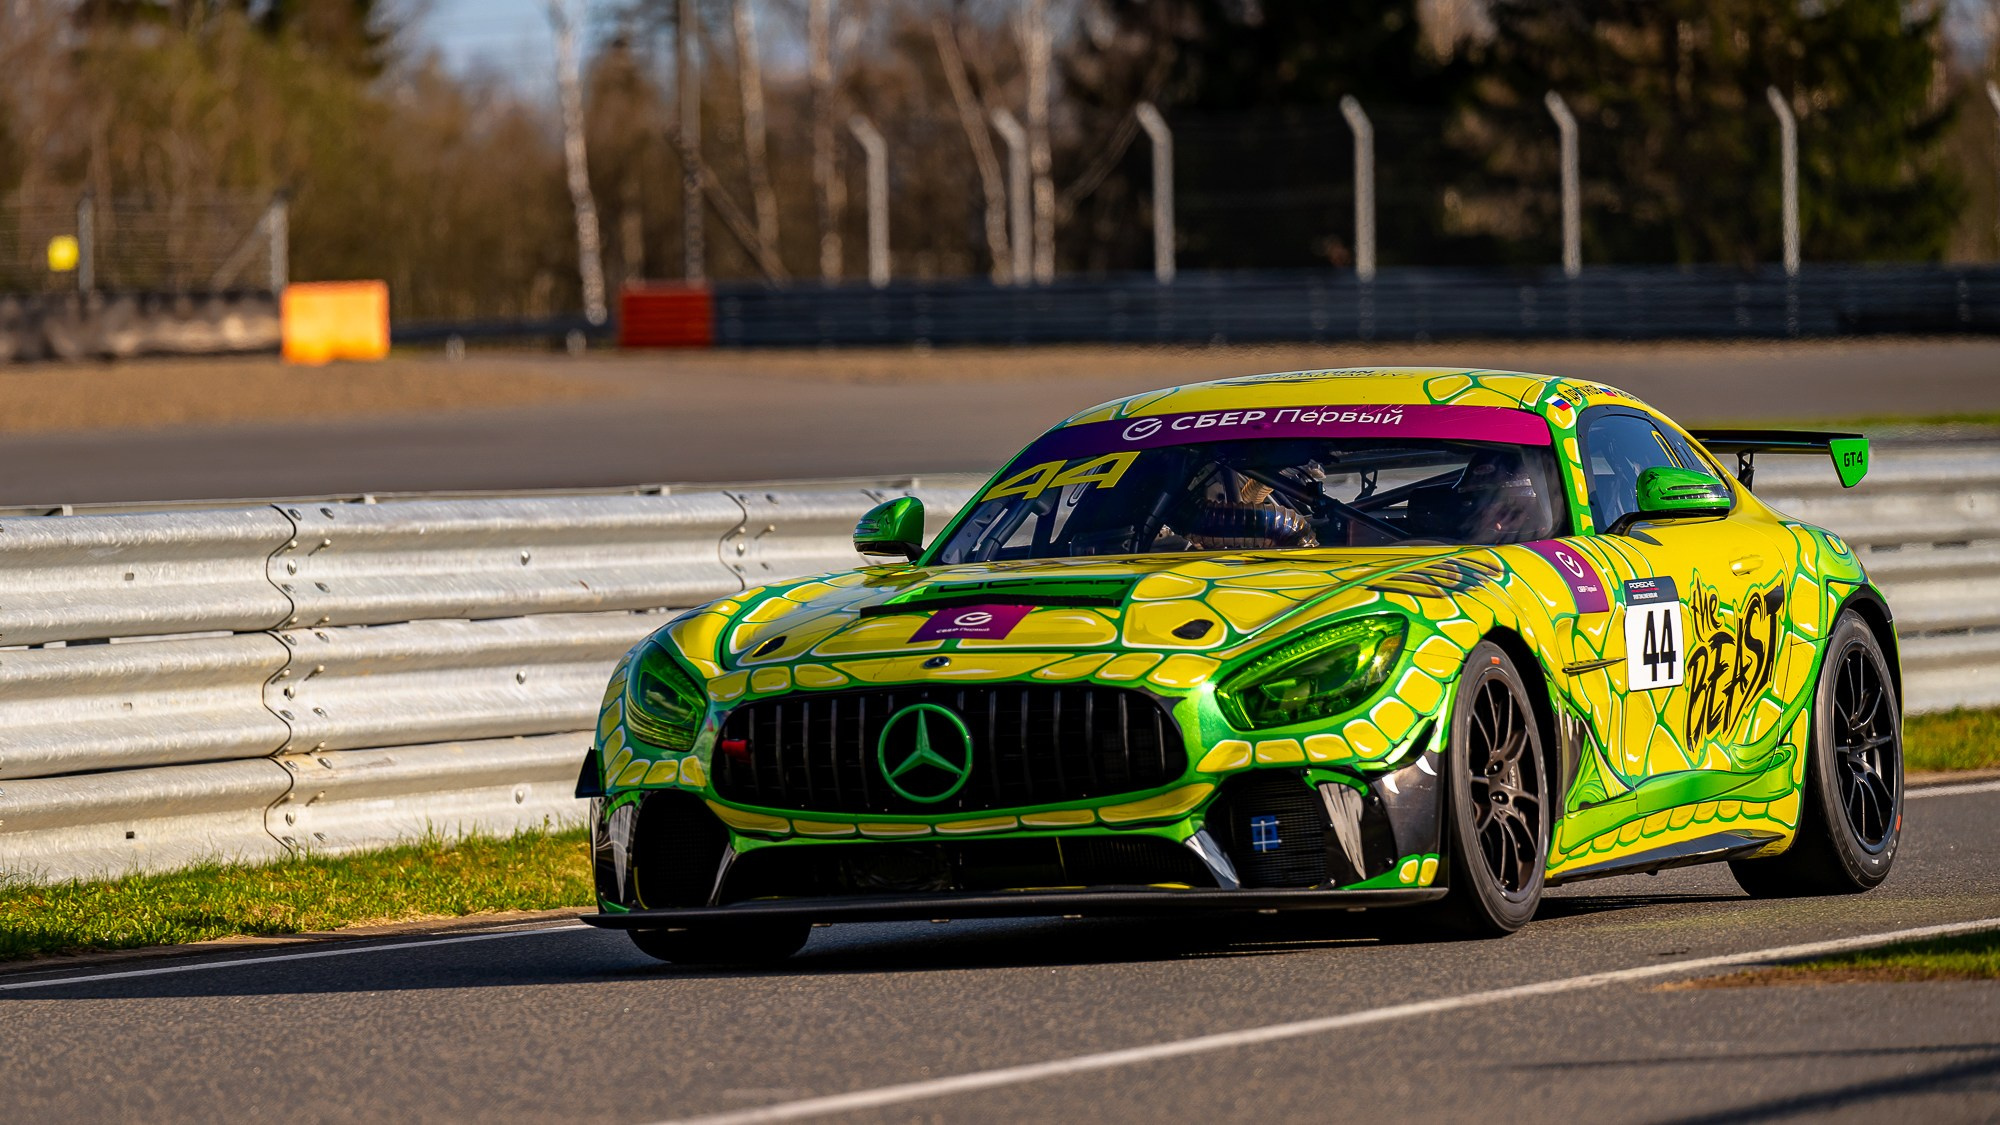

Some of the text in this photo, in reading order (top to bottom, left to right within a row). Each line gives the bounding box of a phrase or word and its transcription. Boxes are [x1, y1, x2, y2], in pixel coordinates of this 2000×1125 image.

[1171, 409, 1404, 430] СБЕР Первый
[981, 451, 1140, 502] 44
[1843, 450, 1864, 468] GT4
[1628, 580, 1656, 589] PORSCHE
[1690, 576, 1723, 643] the
[1643, 609, 1677, 682] 44
[1685, 577, 1785, 753] BEAST
